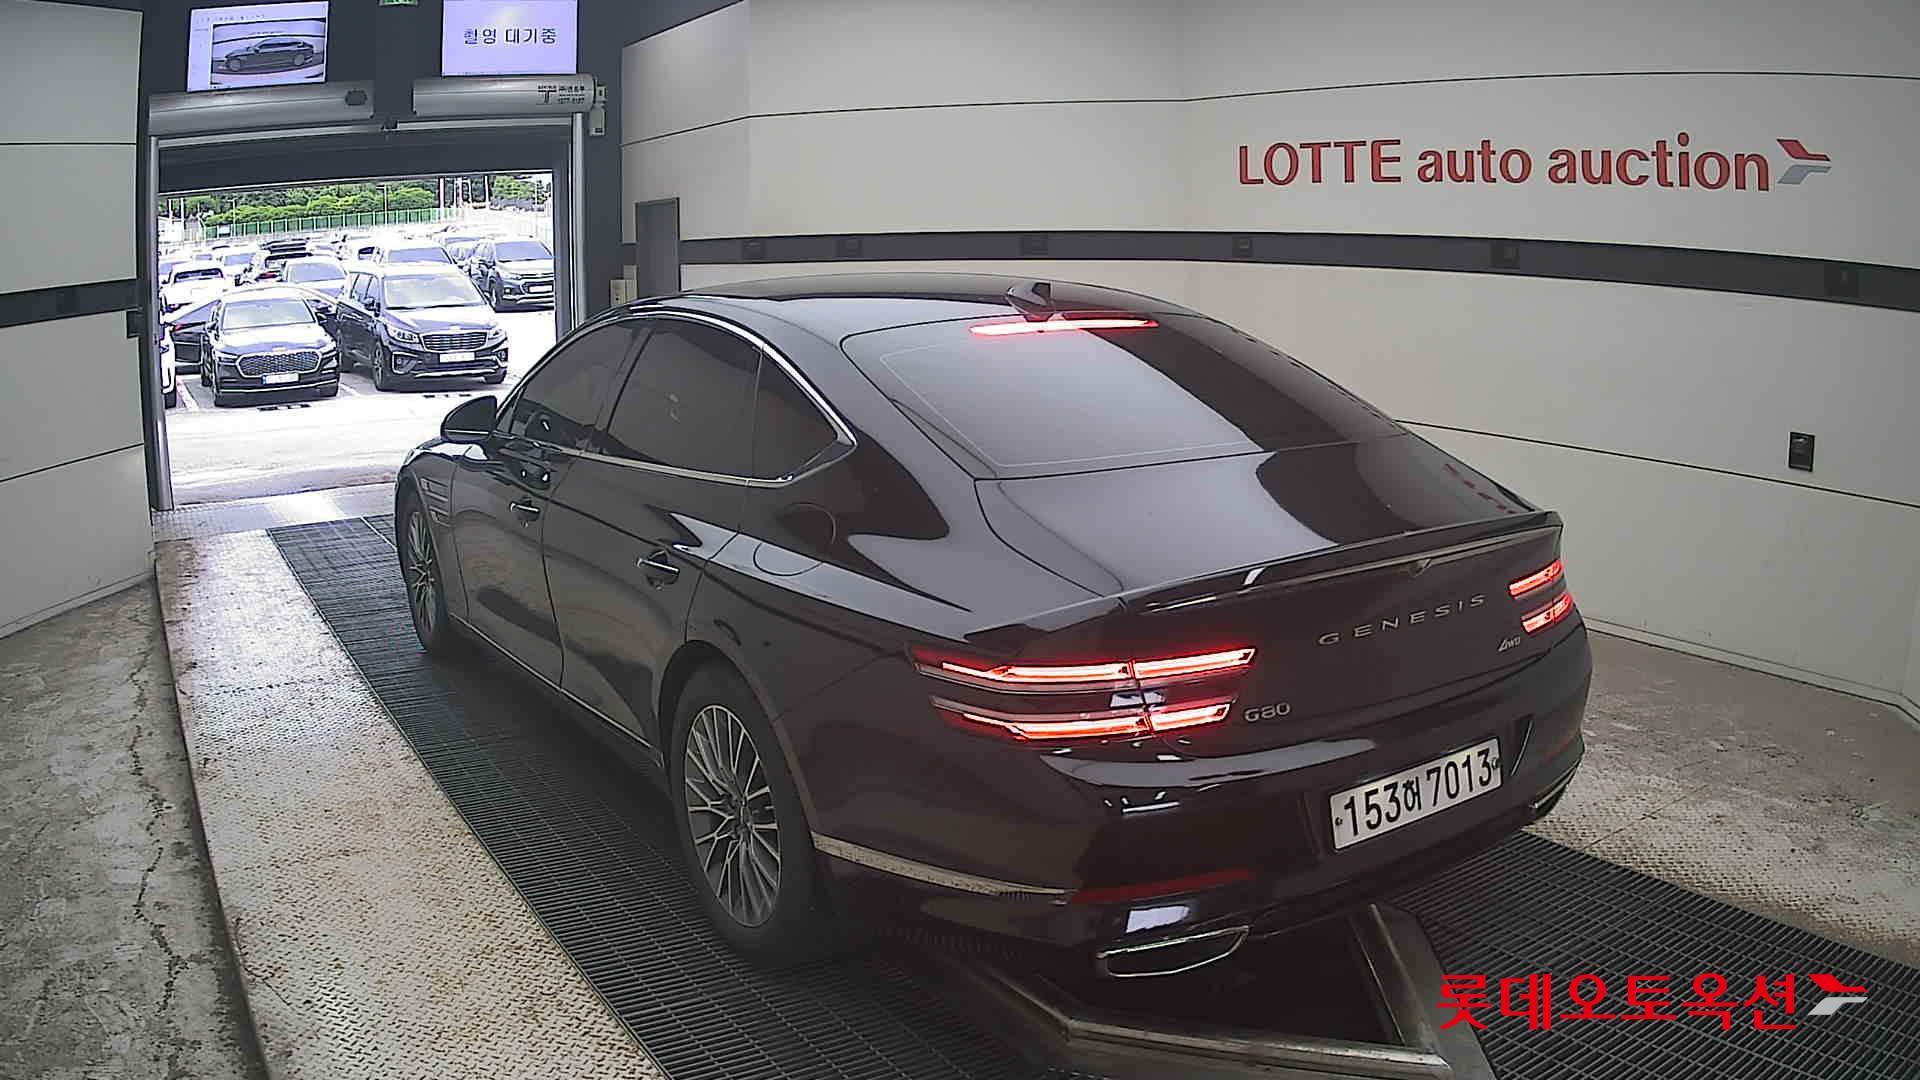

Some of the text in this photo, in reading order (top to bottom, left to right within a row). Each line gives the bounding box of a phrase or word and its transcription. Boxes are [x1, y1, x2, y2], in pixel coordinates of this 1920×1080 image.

[505, 28, 557, 44] 대기중
[1239, 132, 1769, 192] LOTTE auto auction
[1318, 594, 1486, 646] GENESIS
[1243, 702, 1291, 723] G80
[1344, 748, 1492, 836] 153허 7013
